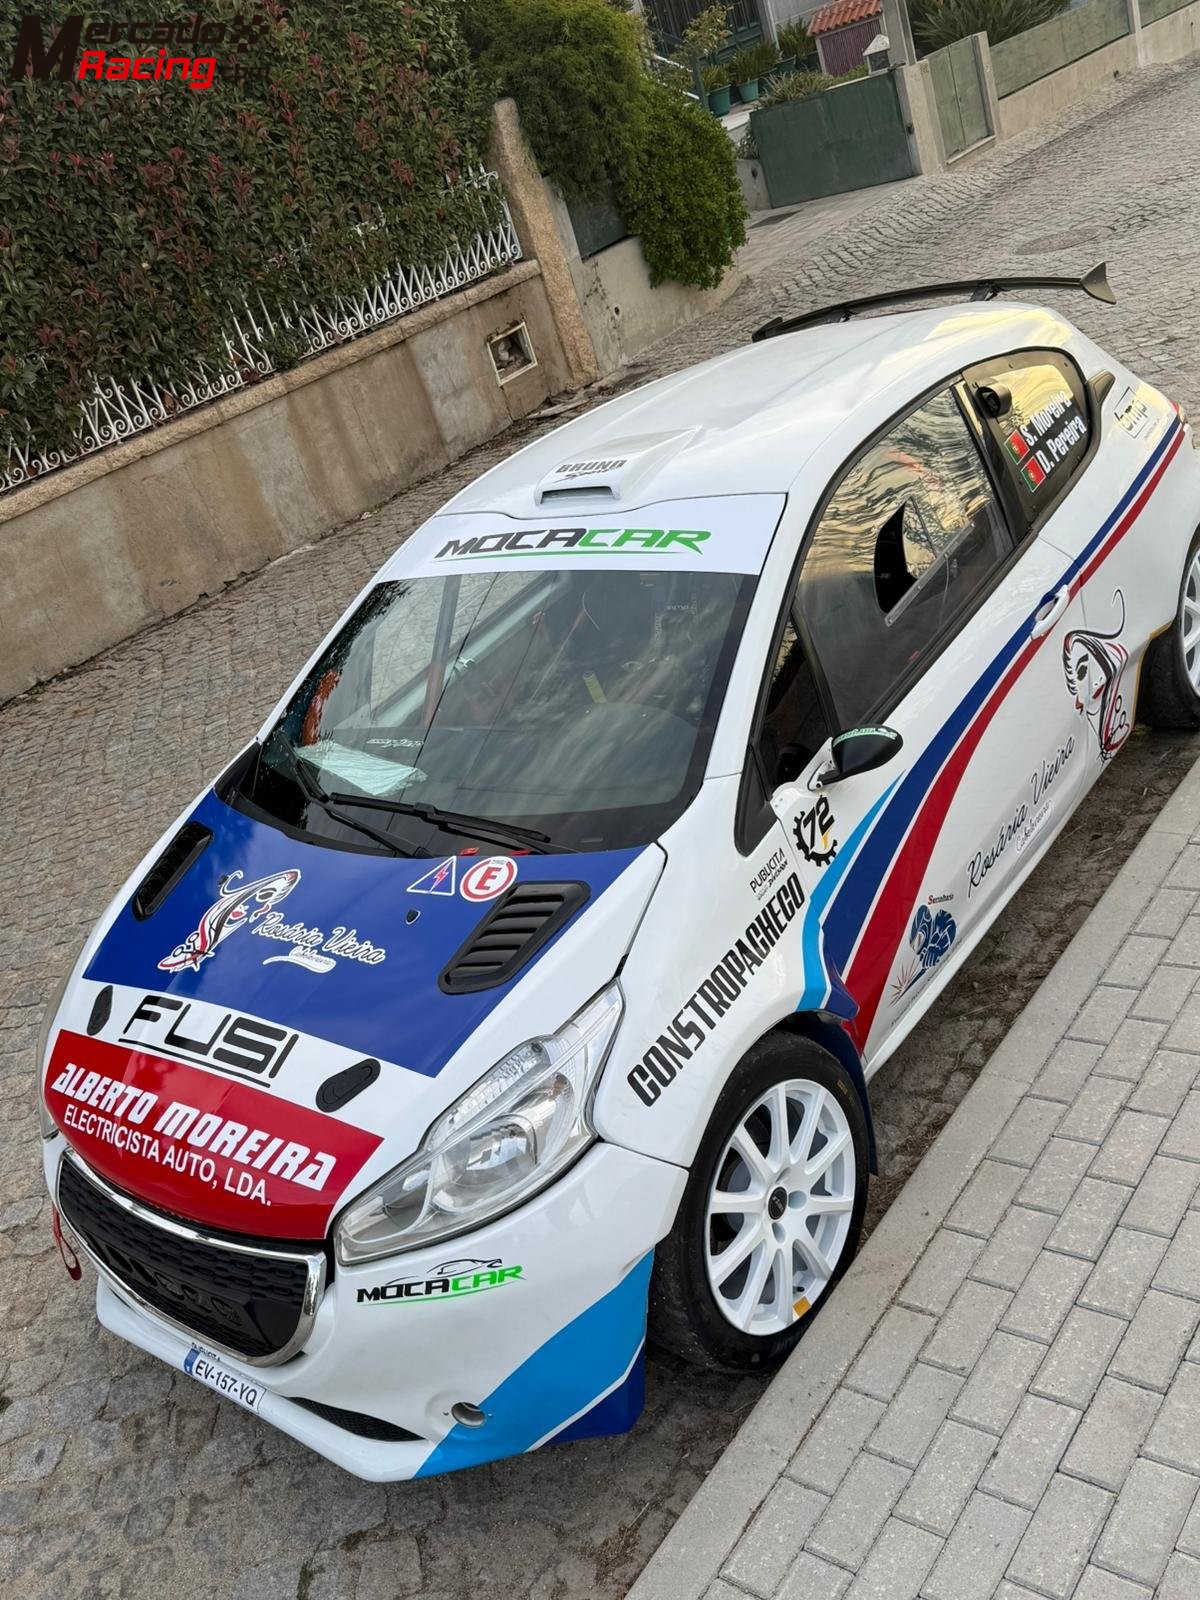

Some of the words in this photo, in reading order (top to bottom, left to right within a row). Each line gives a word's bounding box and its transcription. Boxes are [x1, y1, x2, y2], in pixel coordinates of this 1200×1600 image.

[1020, 424, 1038, 447] S.
[1030, 390, 1072, 436] Moreira
[1035, 450, 1055, 474] D.
[1046, 416, 1087, 462] Pereira
[434, 528, 712, 558] MOCACAR
[1031, 736, 1075, 805] Vieira
[474, 866, 503, 891] E
[322, 926, 386, 965] Vieira
[626, 871, 806, 1107] CONSTROPACHECO
[122, 994, 300, 1079] FUSI
[51, 1062, 159, 1125] ALBERTO
[154, 1101, 337, 1192] MOREIRA
[63, 1103, 160, 1163] ELECTRICISTA
[162, 1145, 218, 1190] AUTO,
[223, 1167, 272, 1206] LDA.
[356, 1265, 524, 1303] MOCACAR
[195, 1359, 258, 1407] EV-157-YQ
